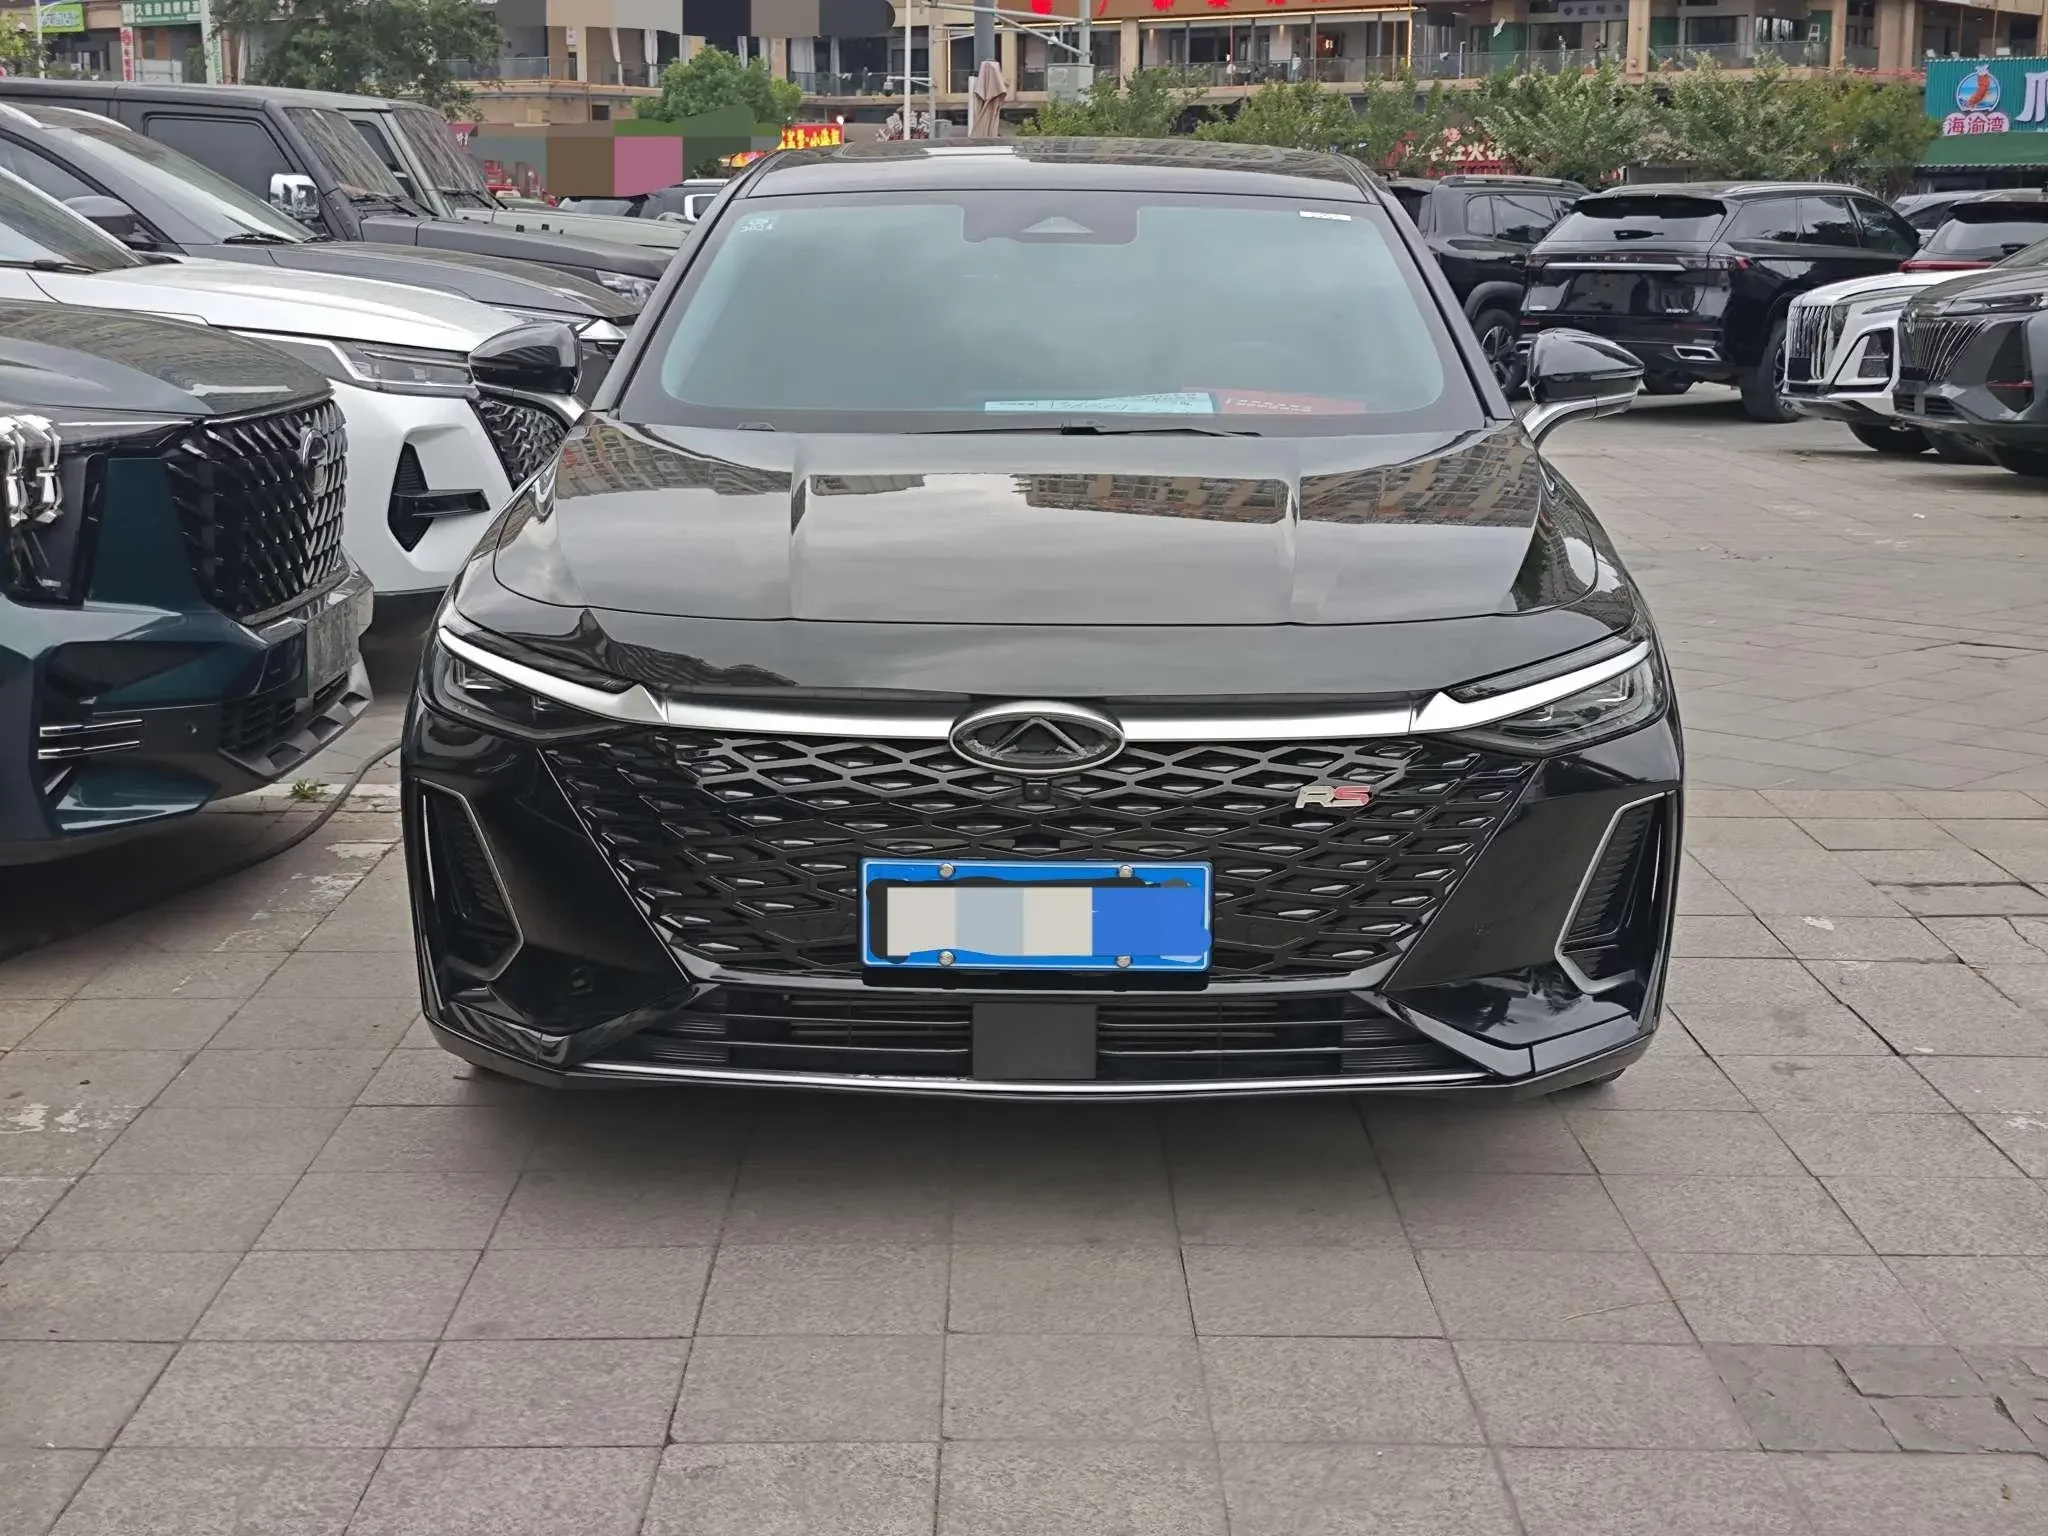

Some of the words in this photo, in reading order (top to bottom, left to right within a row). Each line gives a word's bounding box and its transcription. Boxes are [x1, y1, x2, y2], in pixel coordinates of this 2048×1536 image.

[1947, 116, 2004, 135] 海渝湾
[1295, 785, 1370, 808] RS
